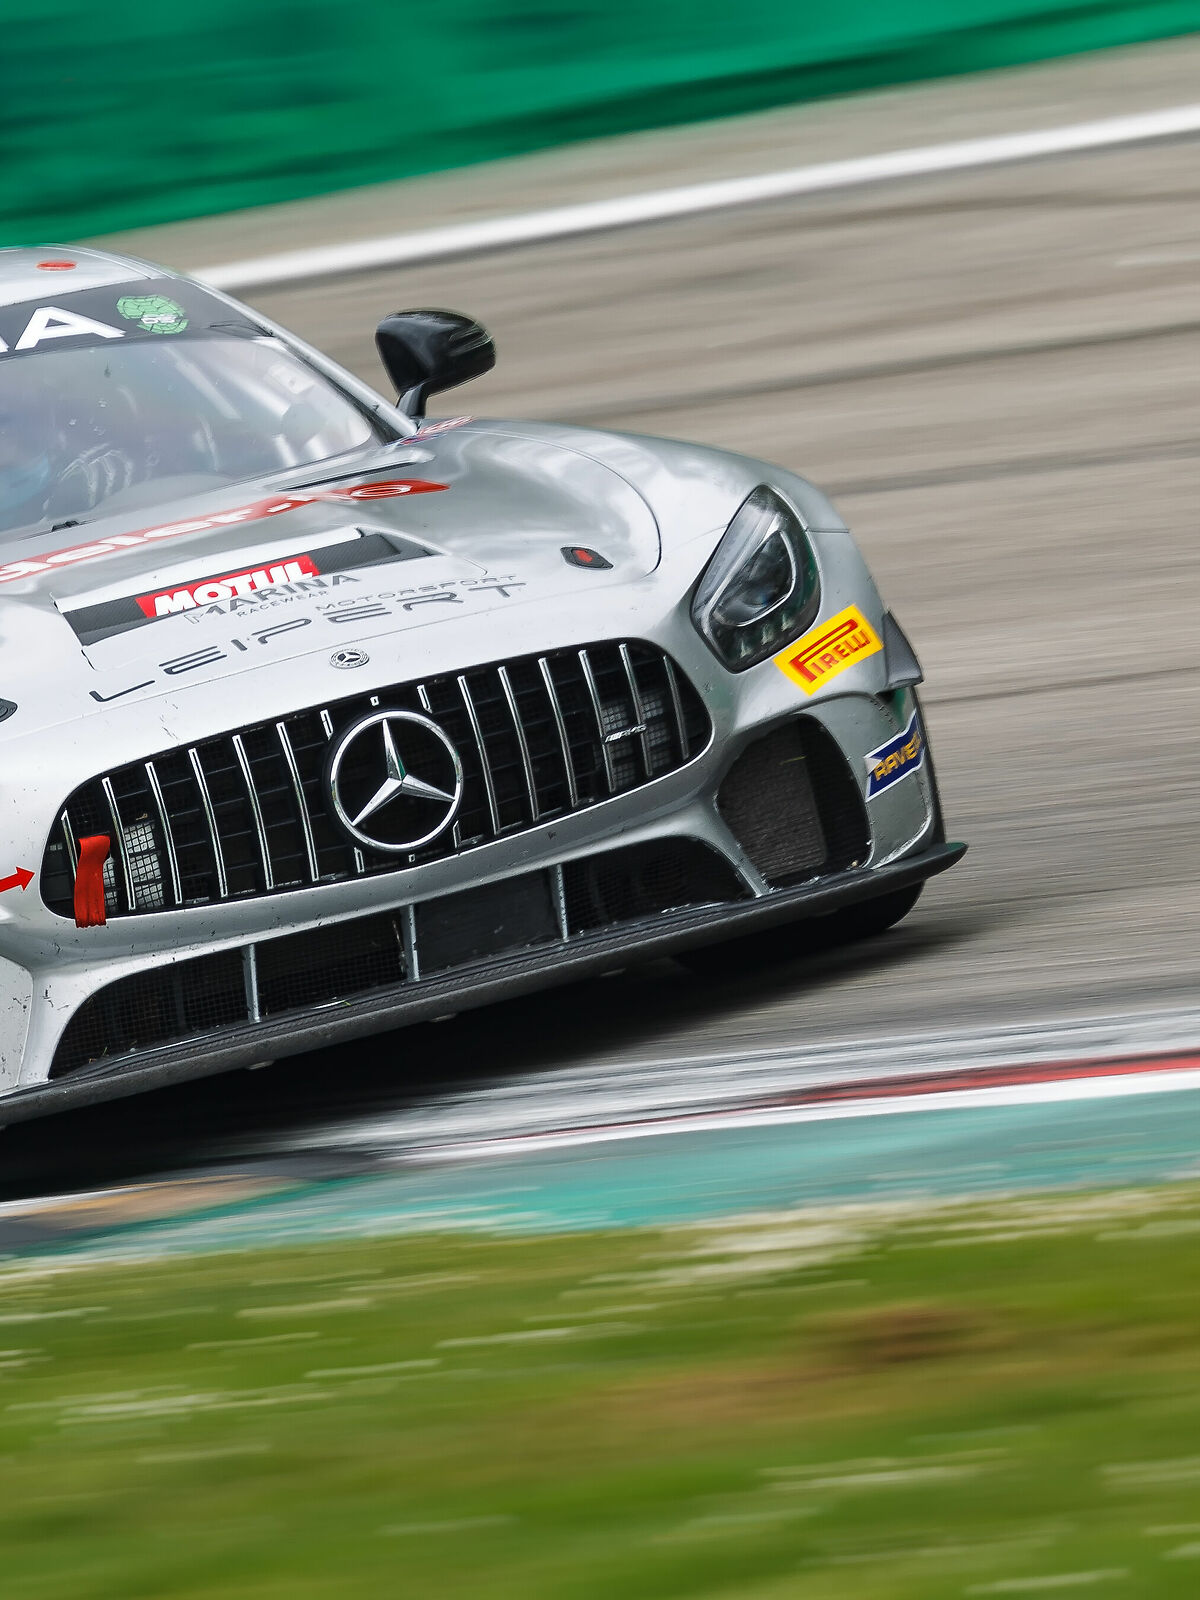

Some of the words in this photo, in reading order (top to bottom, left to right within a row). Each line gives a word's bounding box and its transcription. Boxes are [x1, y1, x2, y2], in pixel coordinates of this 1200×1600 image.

[153, 560, 314, 617] MOTUL
[184, 574, 361, 625] MARINA
[237, 590, 329, 618] RACEWEAR
[315, 575, 517, 611] MOTORSPORT
[89, 582, 527, 703] LEIPERT
[789, 618, 871, 683] PIRELLI
